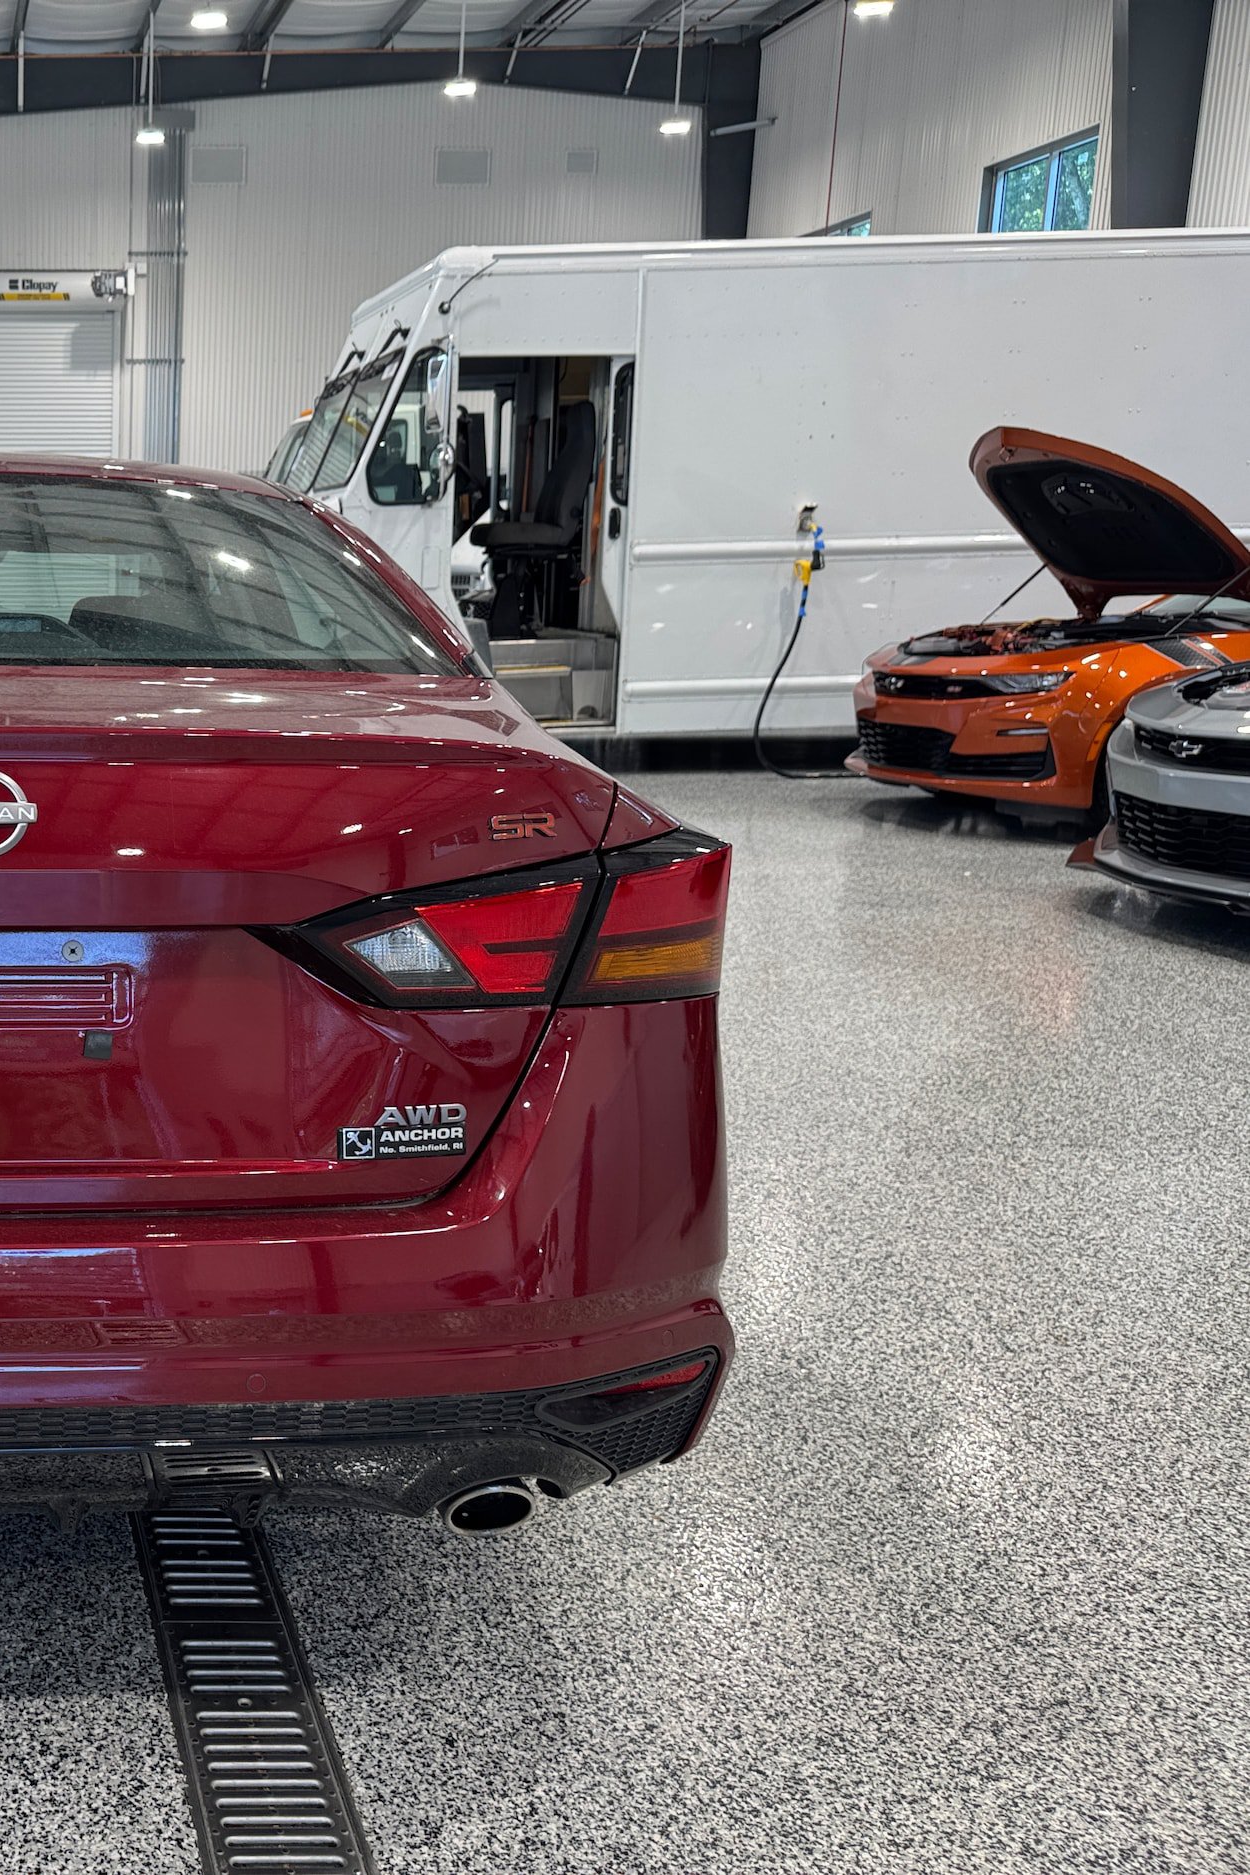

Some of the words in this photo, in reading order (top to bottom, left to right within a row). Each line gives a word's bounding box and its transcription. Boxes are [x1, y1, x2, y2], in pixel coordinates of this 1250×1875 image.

[22, 279, 58, 293] Clopay
[489, 812, 557, 840] SR
[374, 1103, 468, 1127] AWD
[379, 1127, 464, 1143] ANCHOR
[379, 1145, 396, 1154] No.
[399, 1143, 450, 1154] Smithfield,
[452, 1142, 463, 1151] RI
